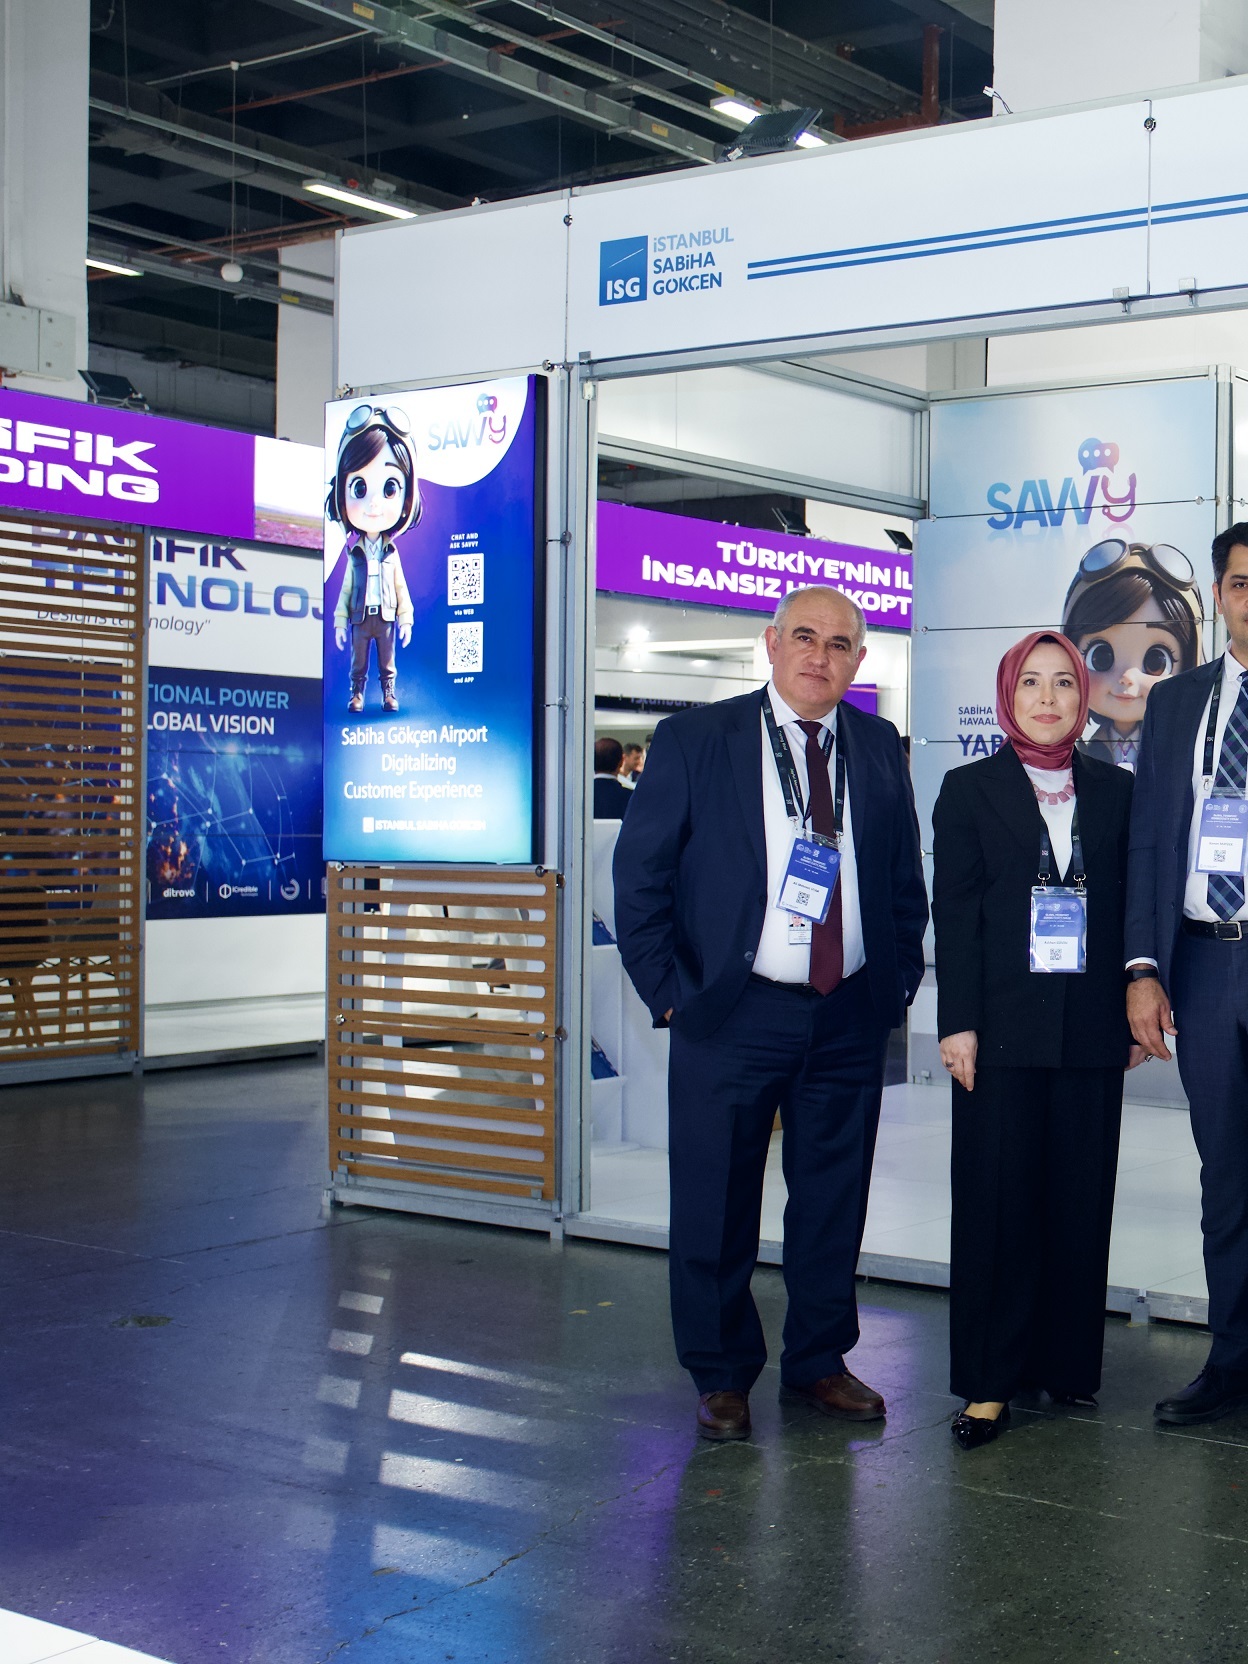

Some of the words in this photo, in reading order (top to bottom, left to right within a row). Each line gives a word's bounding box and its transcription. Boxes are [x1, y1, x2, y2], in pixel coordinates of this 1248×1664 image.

[606, 277, 641, 301] ISG
[461, 540, 479, 549] SAVVY
[466, 532, 479, 540] AND
[716, 541, 891, 588] TÜRKİYE'NİN
[641, 554, 782, 599] İNSANSIZ
[219, 687, 290, 710] POWER
[958, 704, 993, 715] SABİHA
[210, 714, 275, 735] VISION
[959, 717, 999, 726] HAVAAL
[341, 727, 385, 746] Sabiha
[387, 726, 438, 748] Gökçen
[439, 725, 489, 747] Airport
[381, 753, 457, 775] Digitalizing
[344, 781, 407, 800] Customer
[409, 781, 484, 802] Experience
